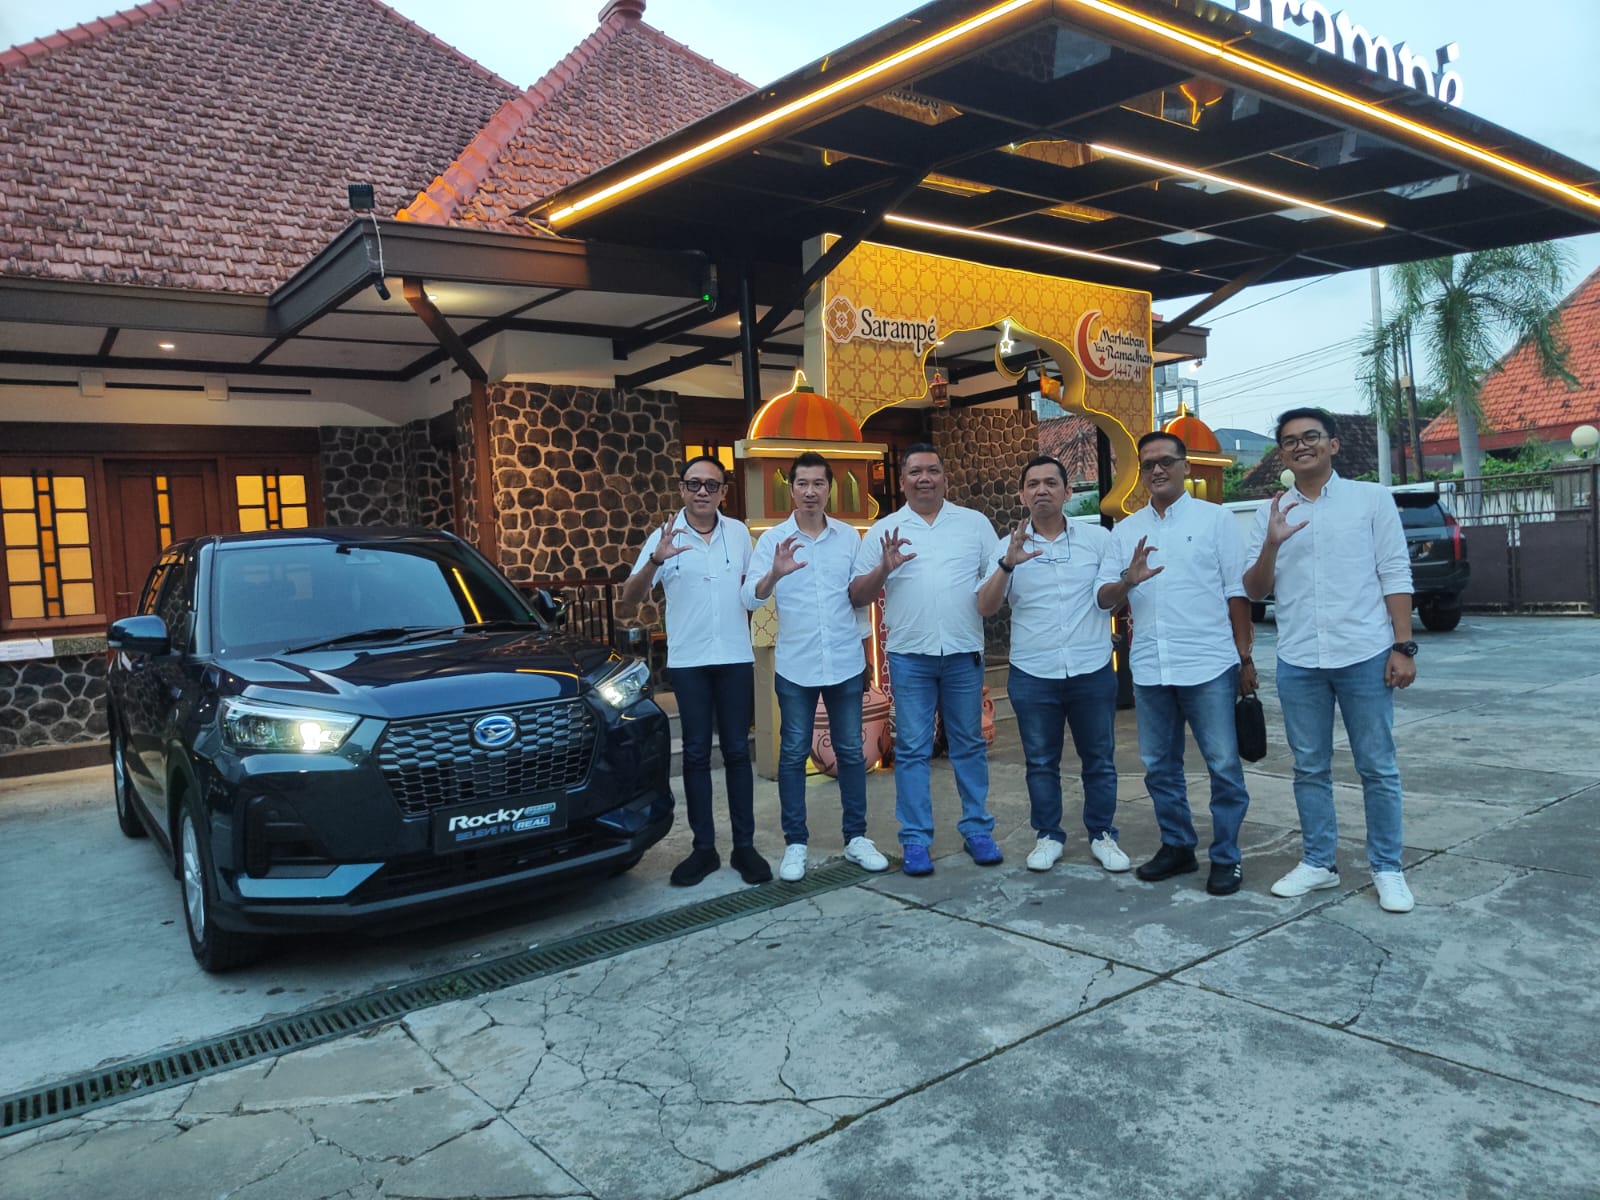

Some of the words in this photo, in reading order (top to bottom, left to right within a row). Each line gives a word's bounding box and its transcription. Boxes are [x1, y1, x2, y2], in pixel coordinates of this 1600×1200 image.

[861, 308, 936, 353] Sarampé
[1100, 329, 1144, 348] Marhaban
[1105, 345, 1152, 364] Ramadhan
[1114, 363, 1132, 377] 1447
[448, 807, 525, 832] Rocky
[516, 817, 547, 829] REAL
